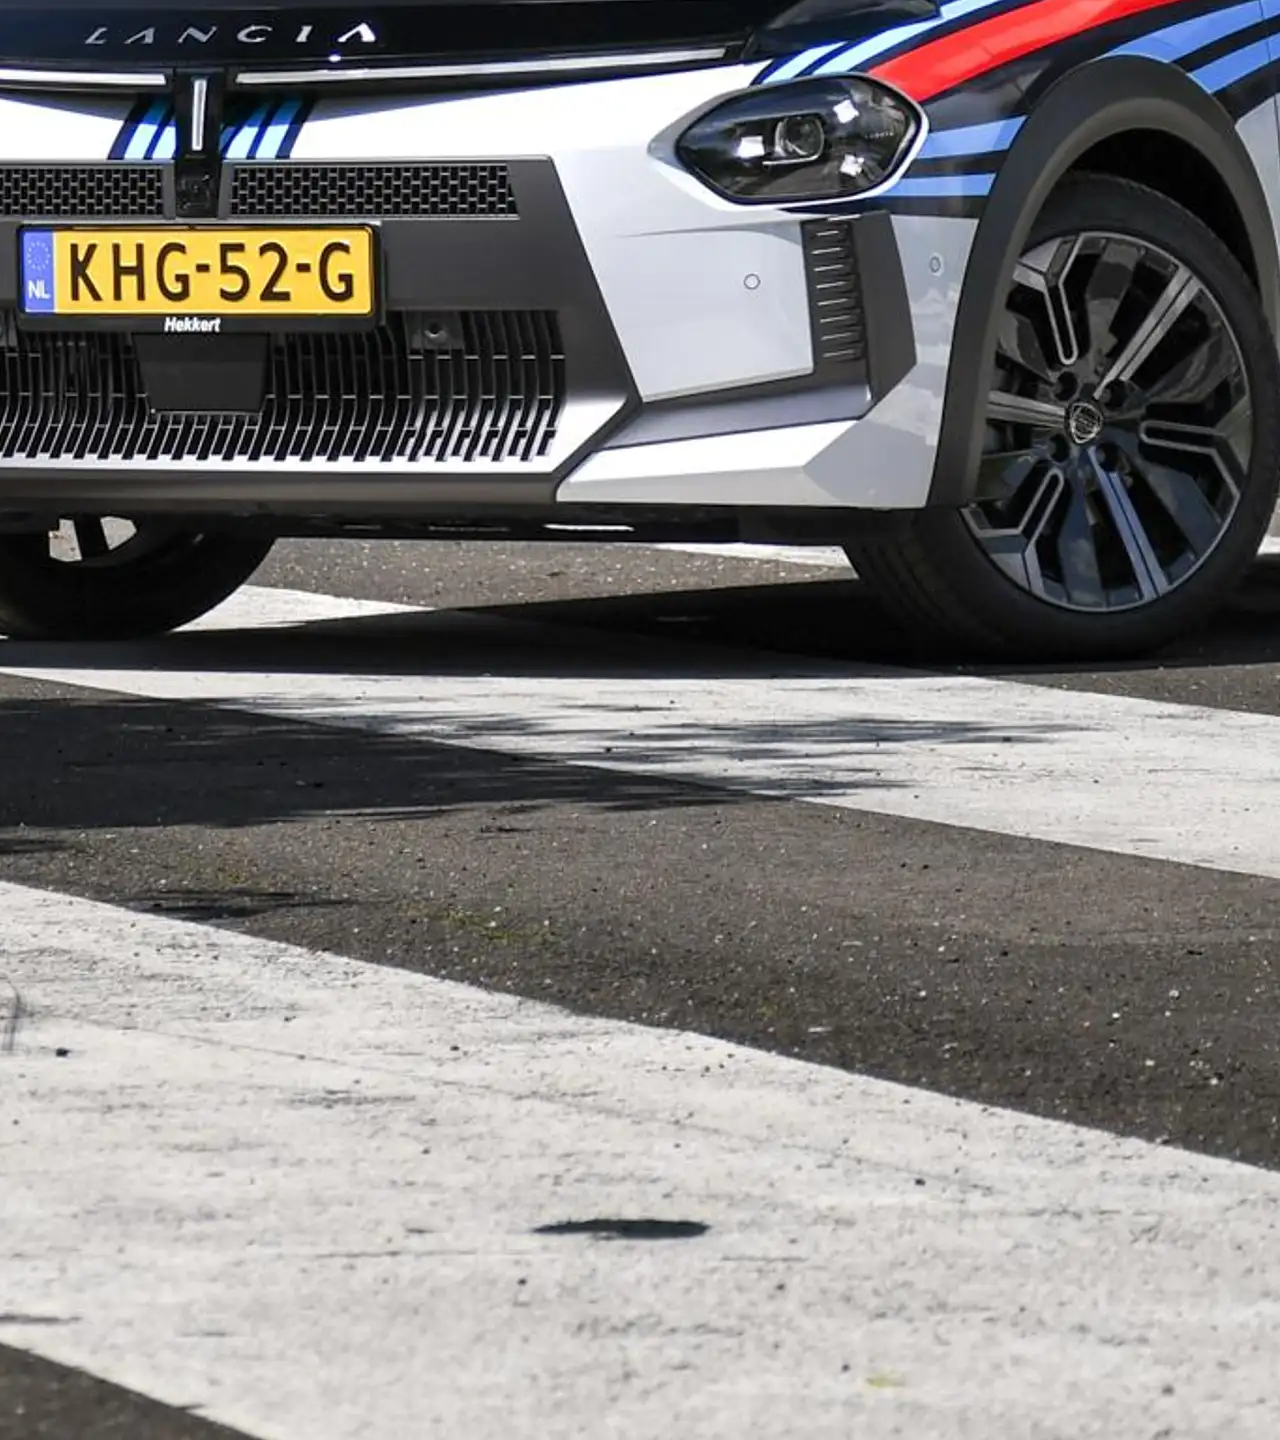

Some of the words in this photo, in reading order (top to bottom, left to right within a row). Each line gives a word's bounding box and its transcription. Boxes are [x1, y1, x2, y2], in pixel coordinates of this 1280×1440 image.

[84, 22, 377, 45] LANCIA
[28, 279, 51, 300] NL
[69, 241, 355, 302] KHG-52-G
[164, 316, 222, 333] Hekkert
